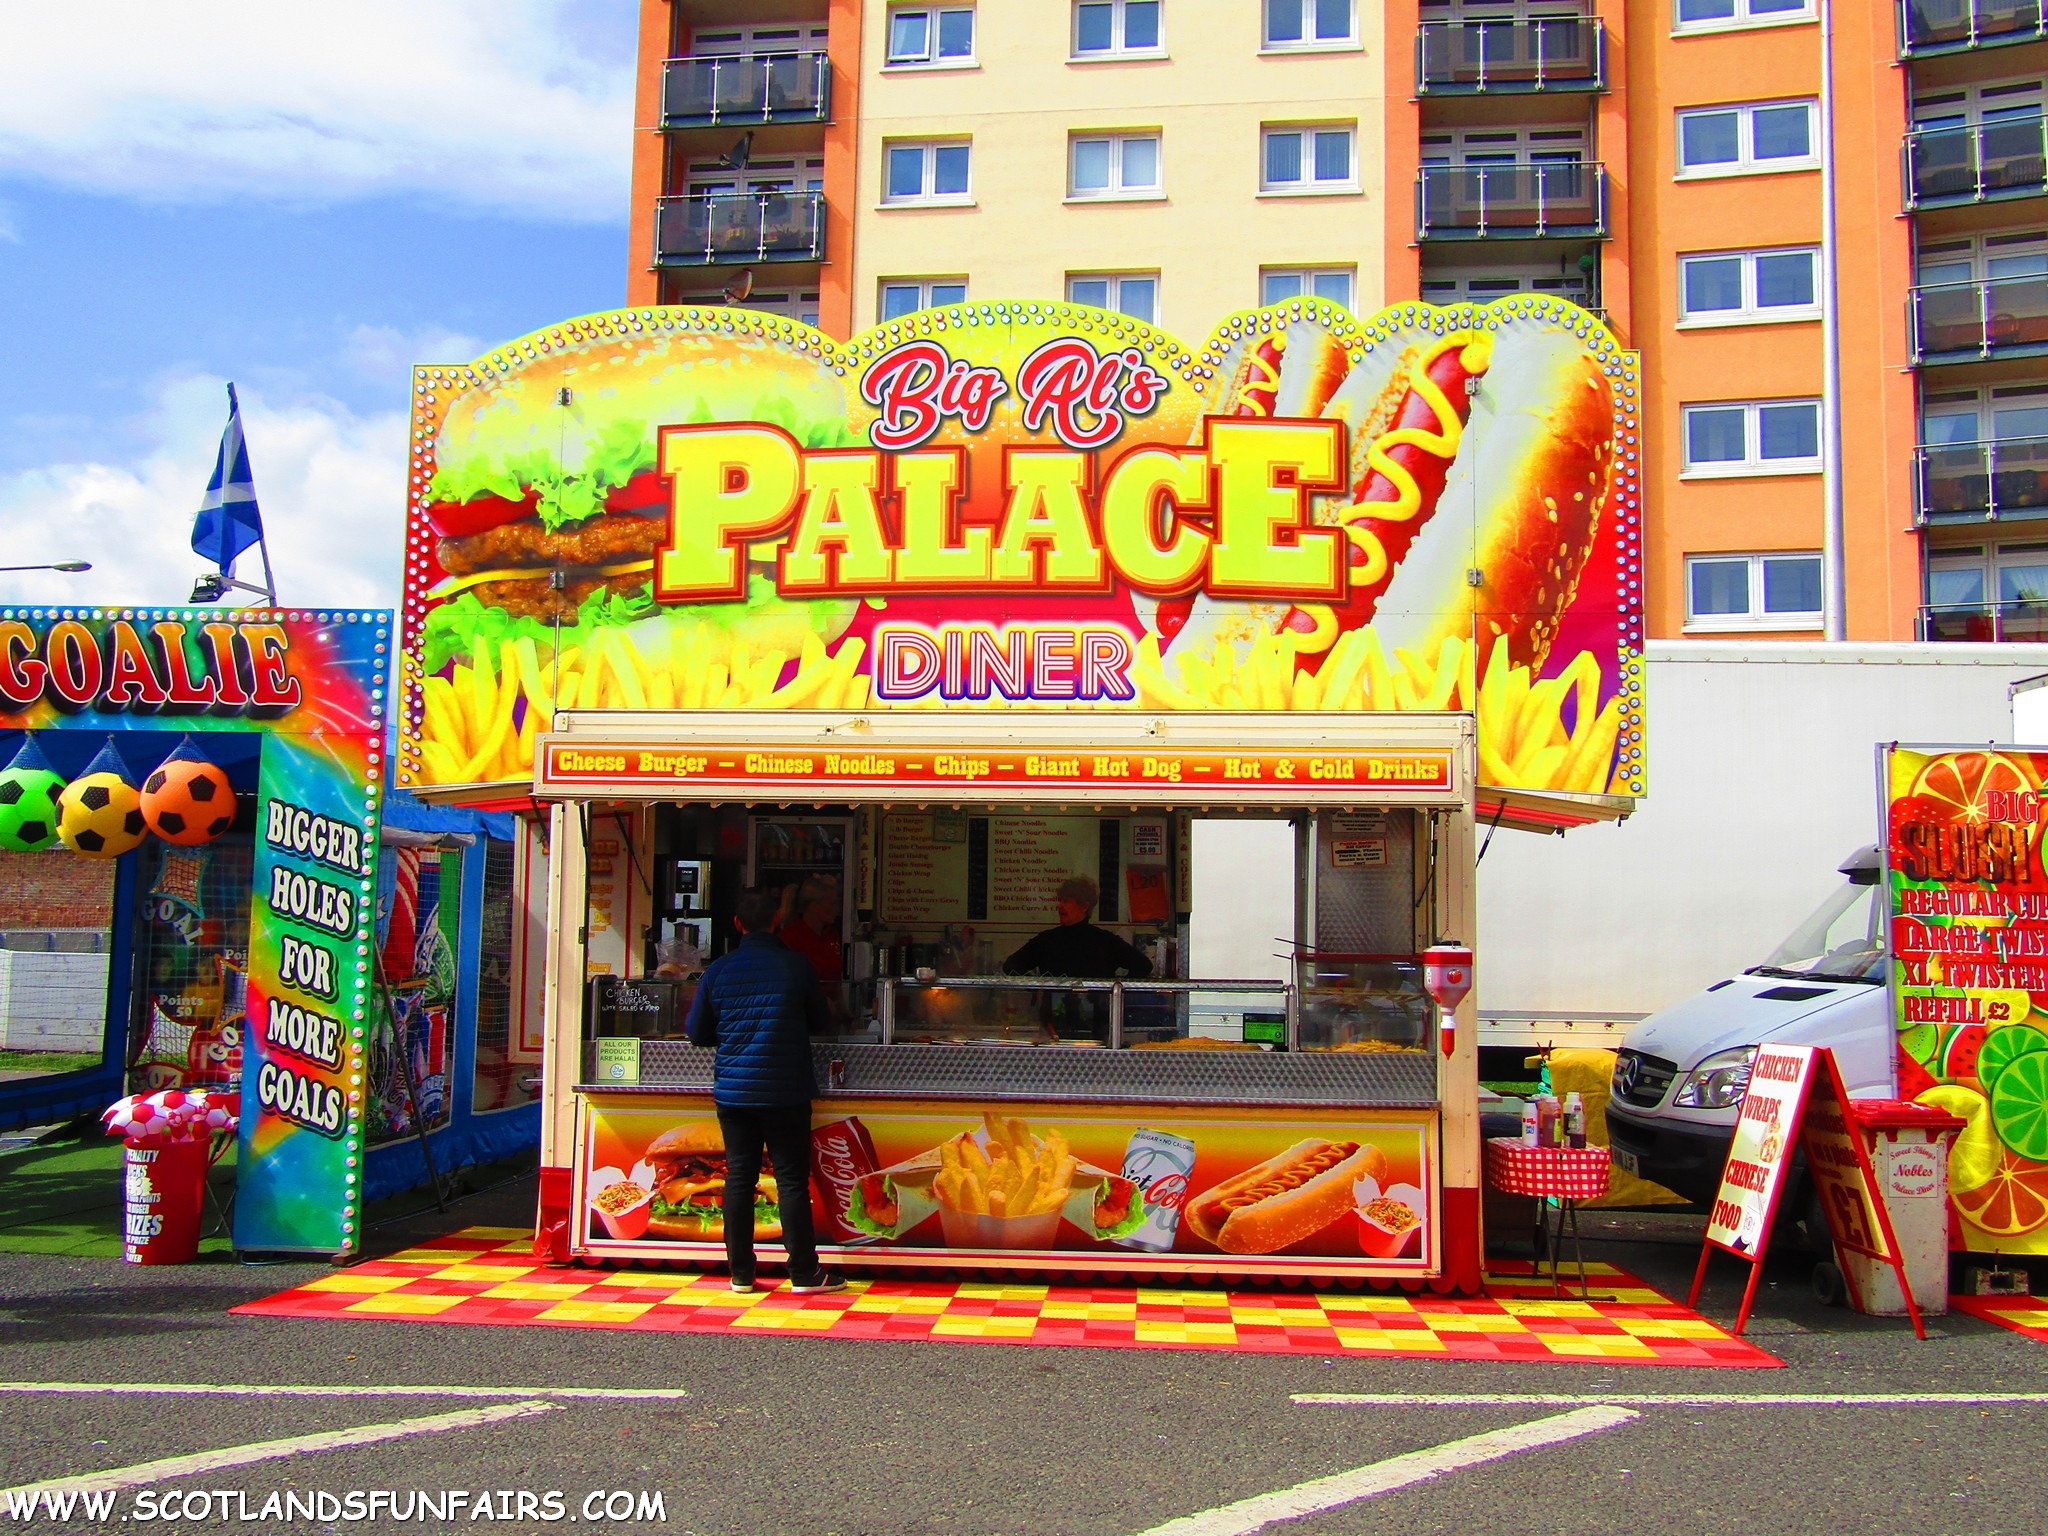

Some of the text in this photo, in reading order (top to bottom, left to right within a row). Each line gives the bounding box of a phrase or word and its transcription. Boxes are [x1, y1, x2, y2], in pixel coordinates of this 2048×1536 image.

[860, 338, 1167, 450] Big Al's
[659, 415, 1350, 598] PALACE
[0, 621, 301, 705] GOALIE
[884, 628, 1136, 700] DINER
[559, 751, 1439, 782] Cheese Burger Chinese Noodles Chips Giant Hot Dog Hot & Cold Drinks
[1985, 790, 2040, 822] BIG
[269, 798, 360, 870] BIGGER
[272, 867, 351, 933] HOLES
[1901, 889, 2008, 918] REGULAR
[143, 900, 204, 946] GOAL
[1901, 924, 1982, 954] LARGE
[280, 936, 332, 994] FOR
[1901, 960, 2045, 991] XL TWISTER
[159, 995, 203, 1006] Points
[606, 988, 640, 998] CHICKEN
[176, 1007, 192, 1017] 50
[1902, 996, 2010, 1024] REFILL £2
[267, 999, 338, 1062] MORE
[1755, 1054, 1803, 1083] CHICKEN
[259, 1063, 341, 1131] GOALS
[1743, 1094, 1782, 1123] WRAPS
[1140, 1134, 1159, 1142] SUGAR
[1890, 1146, 1936, 1160] Sweet Things
[1725, 1159, 1769, 1194] CHINESE
[1893, 1164, 1933, 1176] Nobles
[1712, 1199, 1742, 1232] FOOD
[1830, 1182, 1875, 1250] £7
